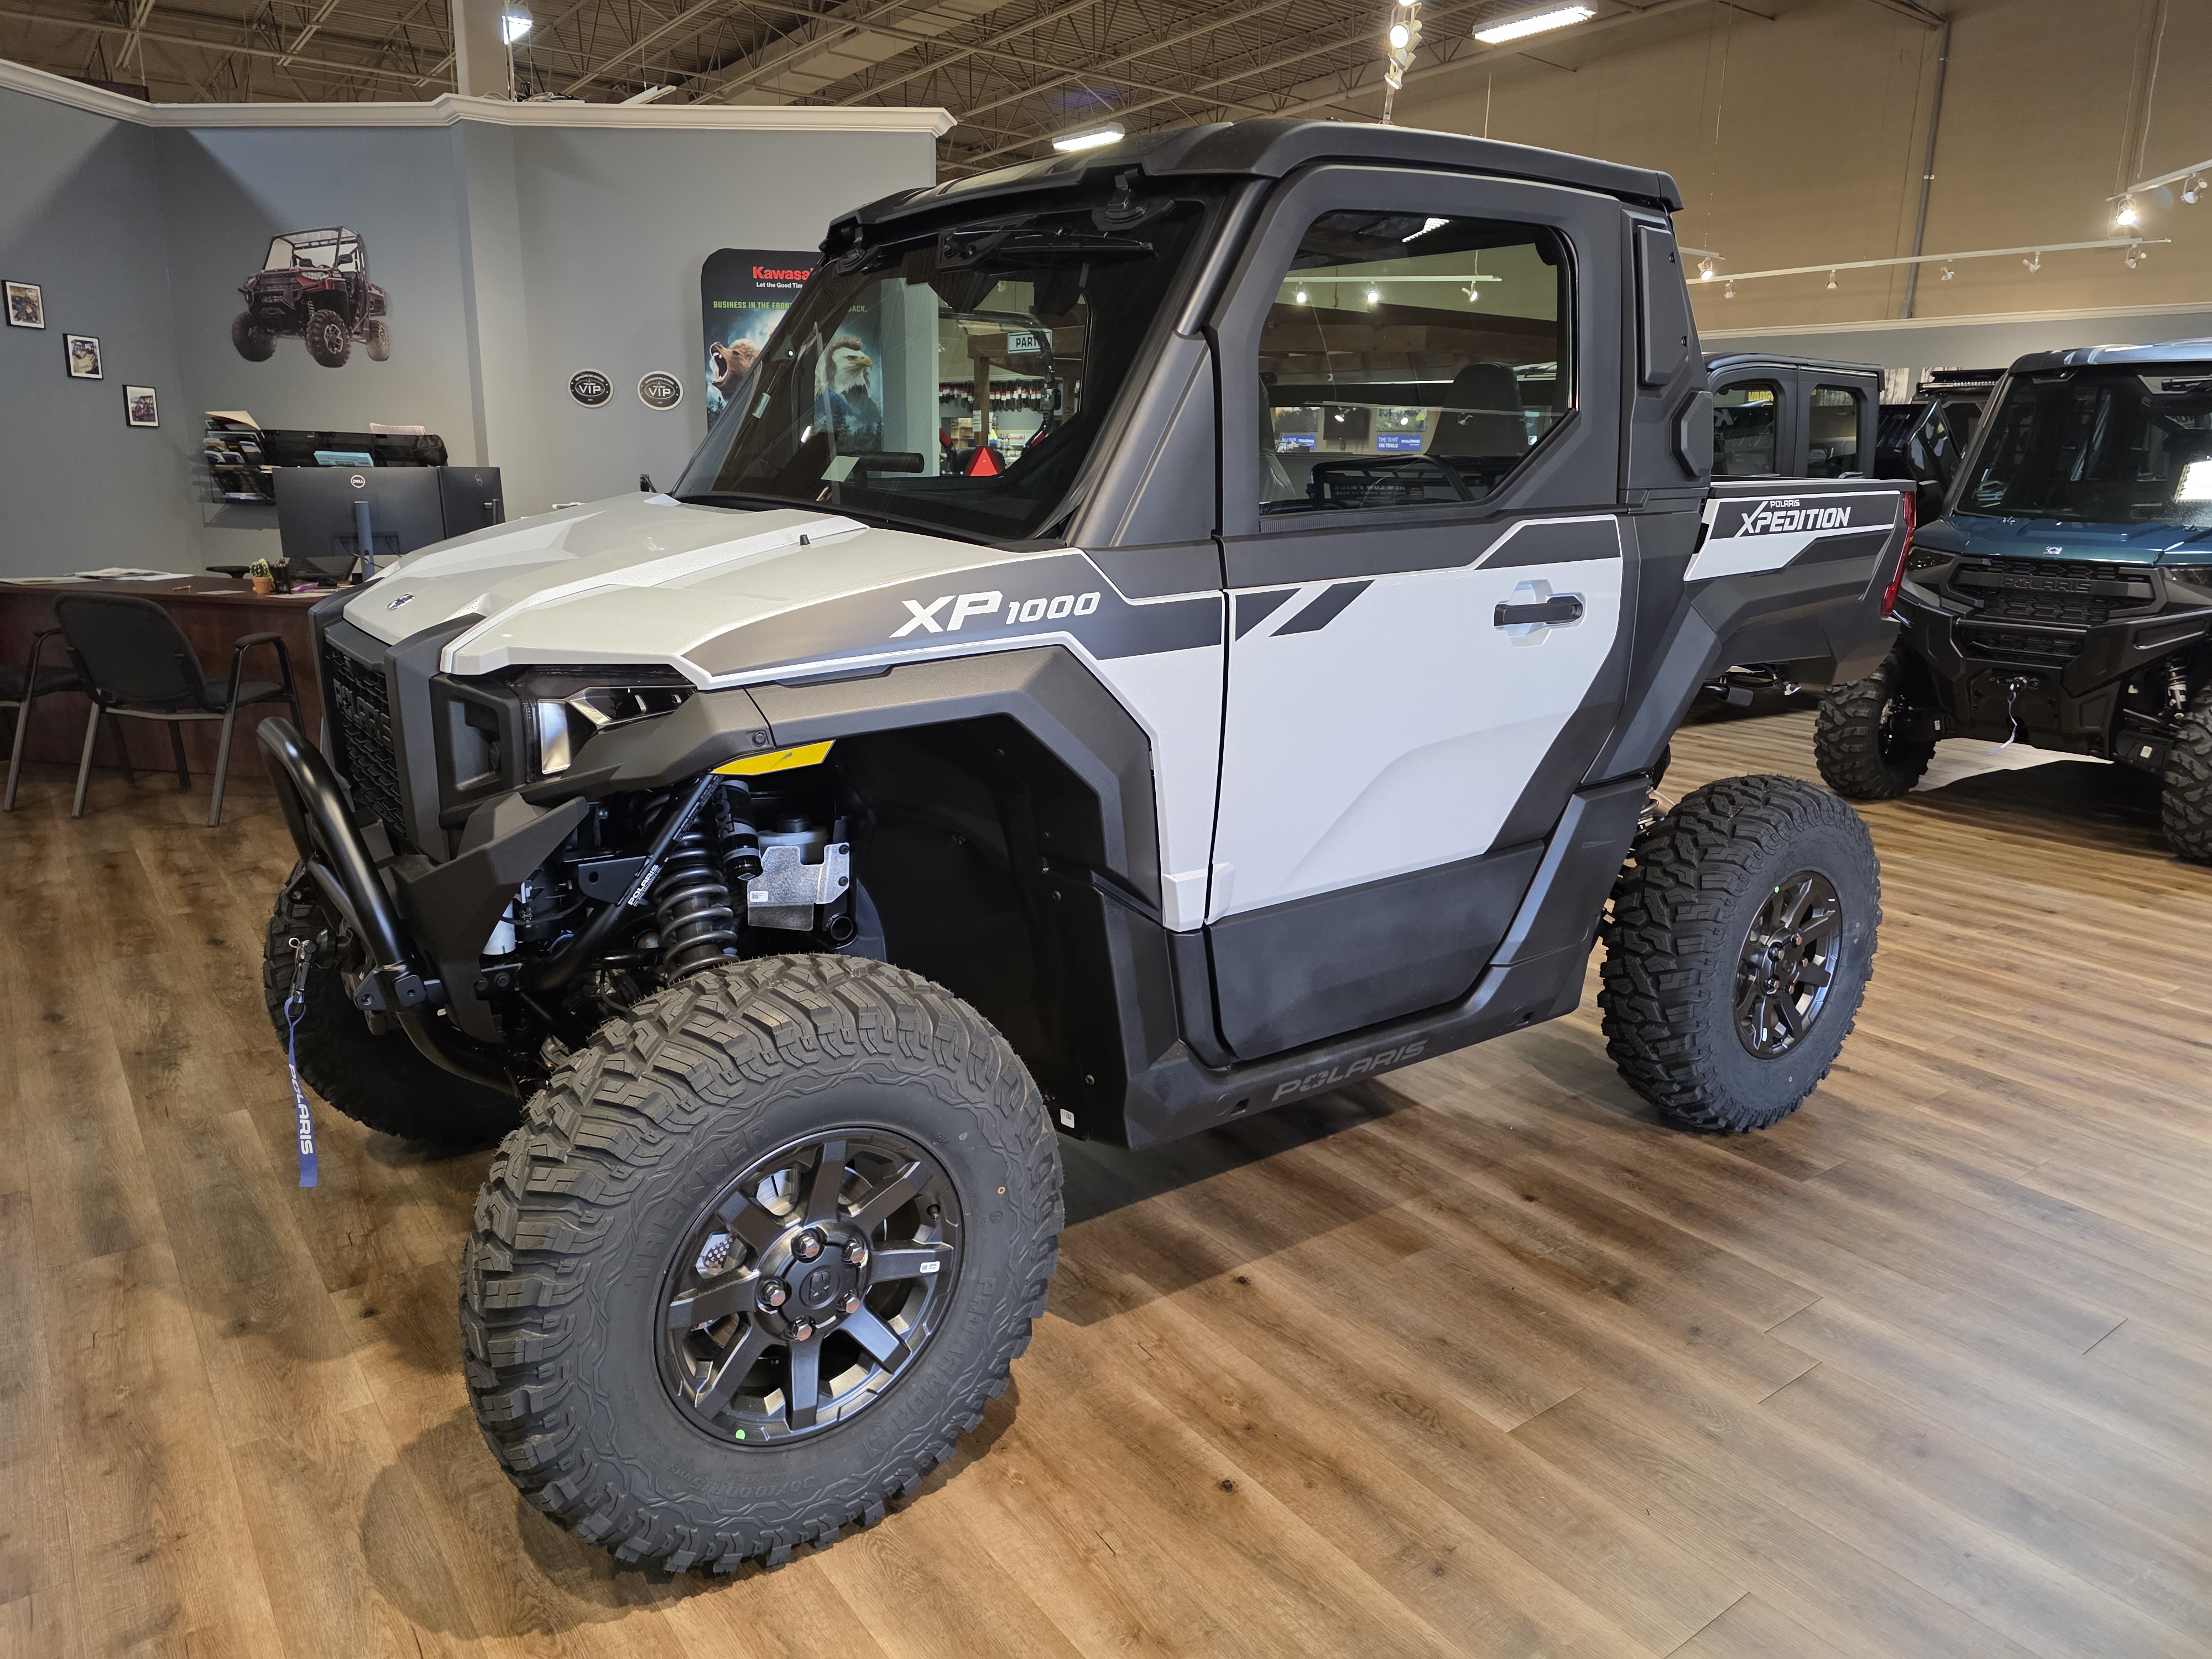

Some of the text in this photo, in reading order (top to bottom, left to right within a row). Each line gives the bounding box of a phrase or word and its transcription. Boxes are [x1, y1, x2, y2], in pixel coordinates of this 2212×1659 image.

[753, 266, 813, 280] Kawasa
[578, 384, 601, 394] VIP
[648, 388, 671, 397] VIP
[1734, 500, 1851, 538] XPEDITION
[1770, 499, 1800, 508] POLARIS
[2000, 576, 2091, 593] POLARIS
[889, 590, 1101, 638] XP 1000
[333, 678, 394, 750] POLARIS
[628, 864, 659, 905] POLARIS
[1271, 1038, 1429, 1102] POLARIS
[289, 1063, 314, 1155] POLARIS
[890, 1276, 998, 1431] PRO ARMOR
